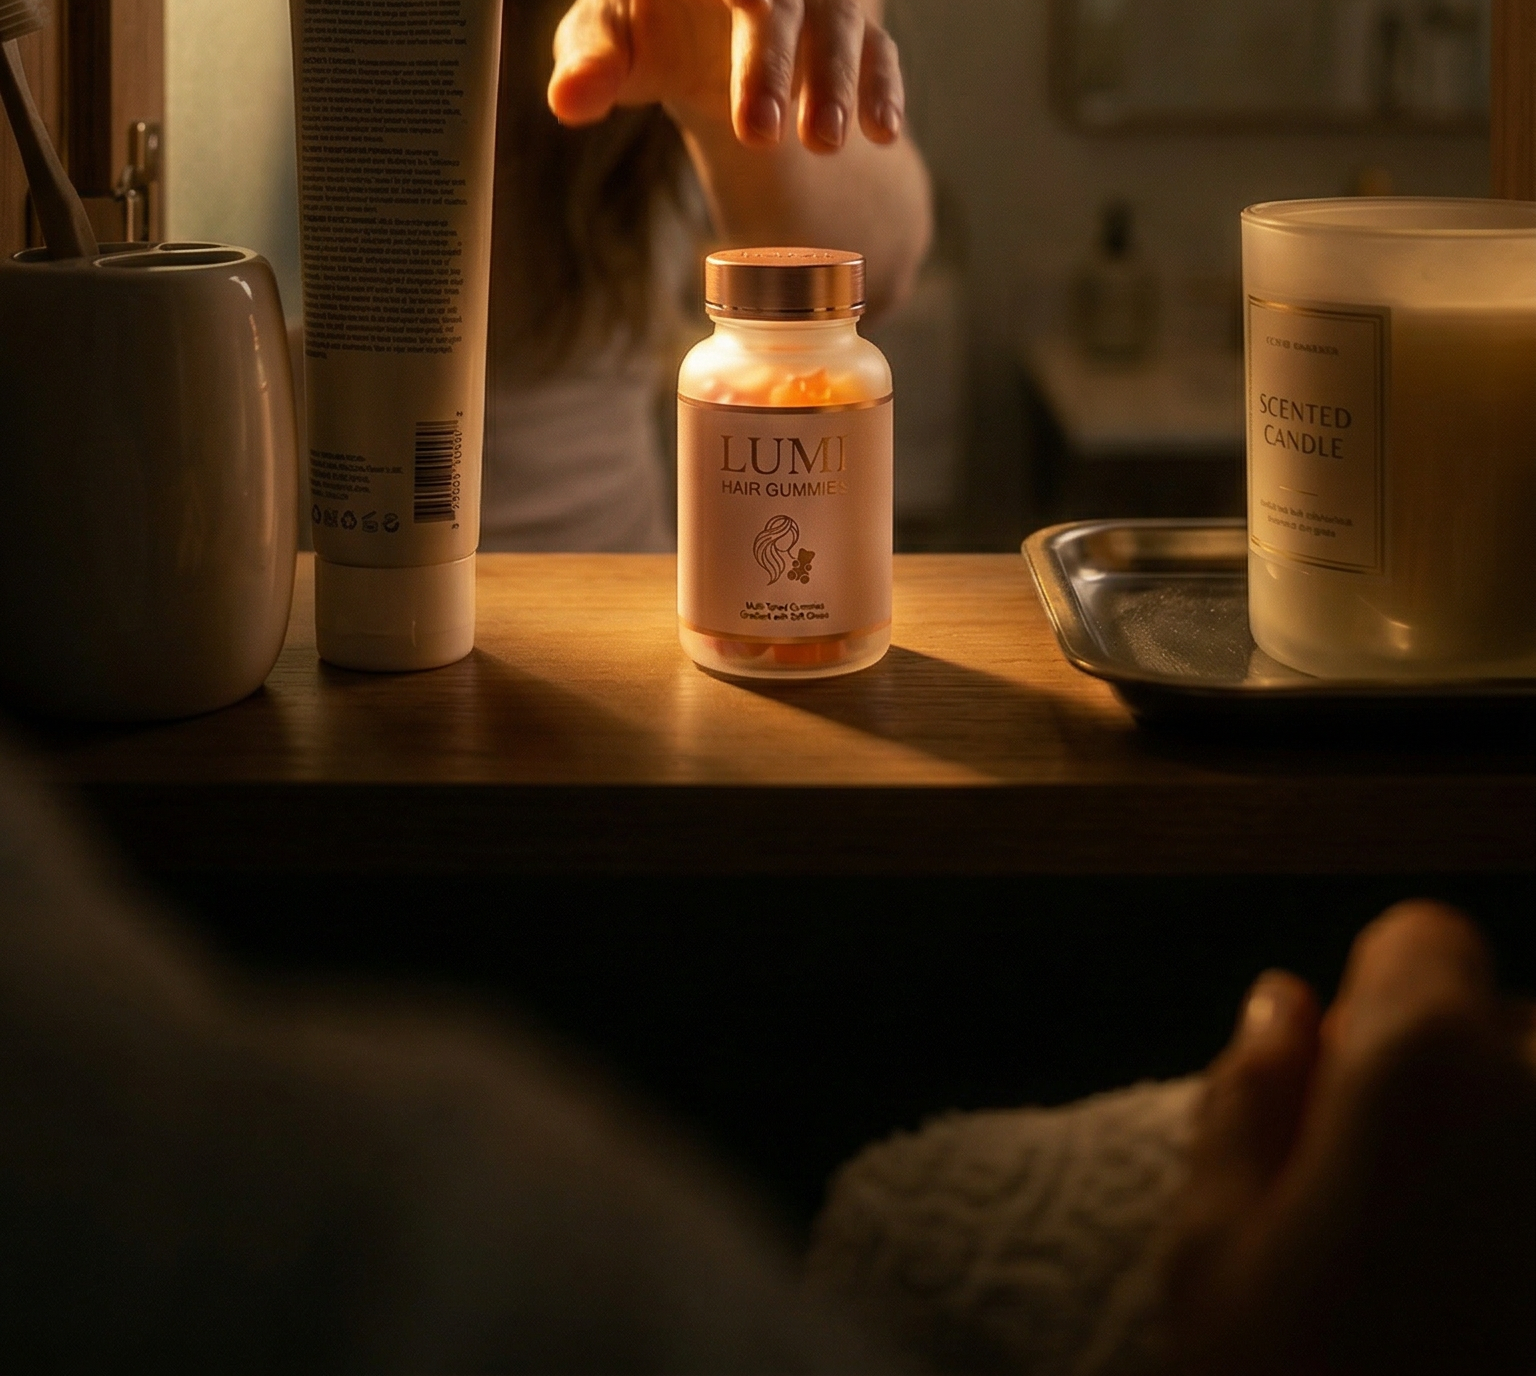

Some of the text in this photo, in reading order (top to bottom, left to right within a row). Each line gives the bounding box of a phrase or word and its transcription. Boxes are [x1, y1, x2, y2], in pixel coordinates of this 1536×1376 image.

[1259, 392, 1353, 430] SCENTED
[719, 433, 849, 475] LUMI
[1263, 423, 1345, 461] CANDLE
[721, 480, 848, 498] HAIR GUMMIES
